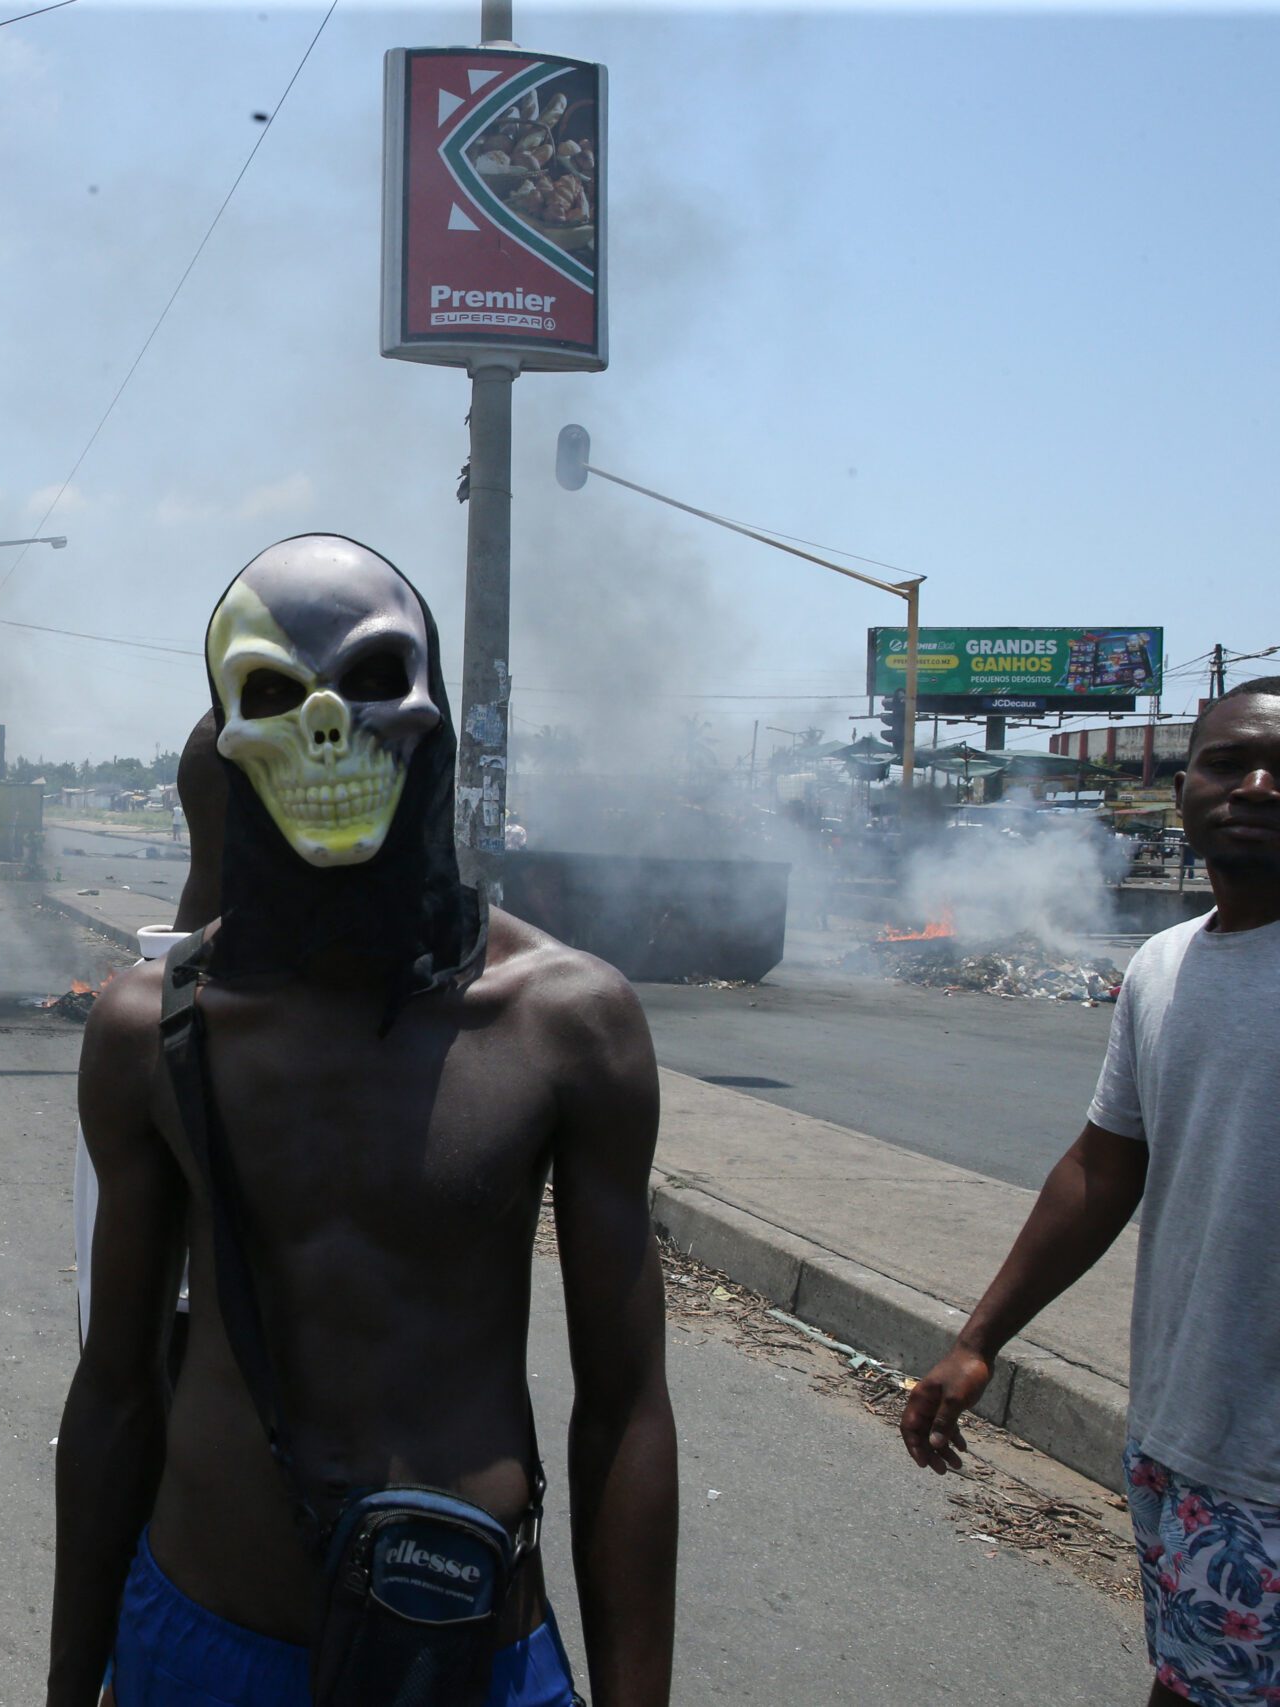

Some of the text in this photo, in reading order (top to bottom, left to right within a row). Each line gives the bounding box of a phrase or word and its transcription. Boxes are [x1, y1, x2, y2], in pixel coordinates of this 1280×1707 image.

[431, 285, 556, 313] Premier
[434, 313, 542, 327] SUPERSPAR
[966, 639, 1058, 655] GRANDES
[971, 656, 1053, 672] GANHOS
[970, 674, 1052, 683] PEQUENOS DEPÓSITOS
[992, 699, 1037, 708] JCDecaux
[385, 1540, 481, 1583] ellesse
